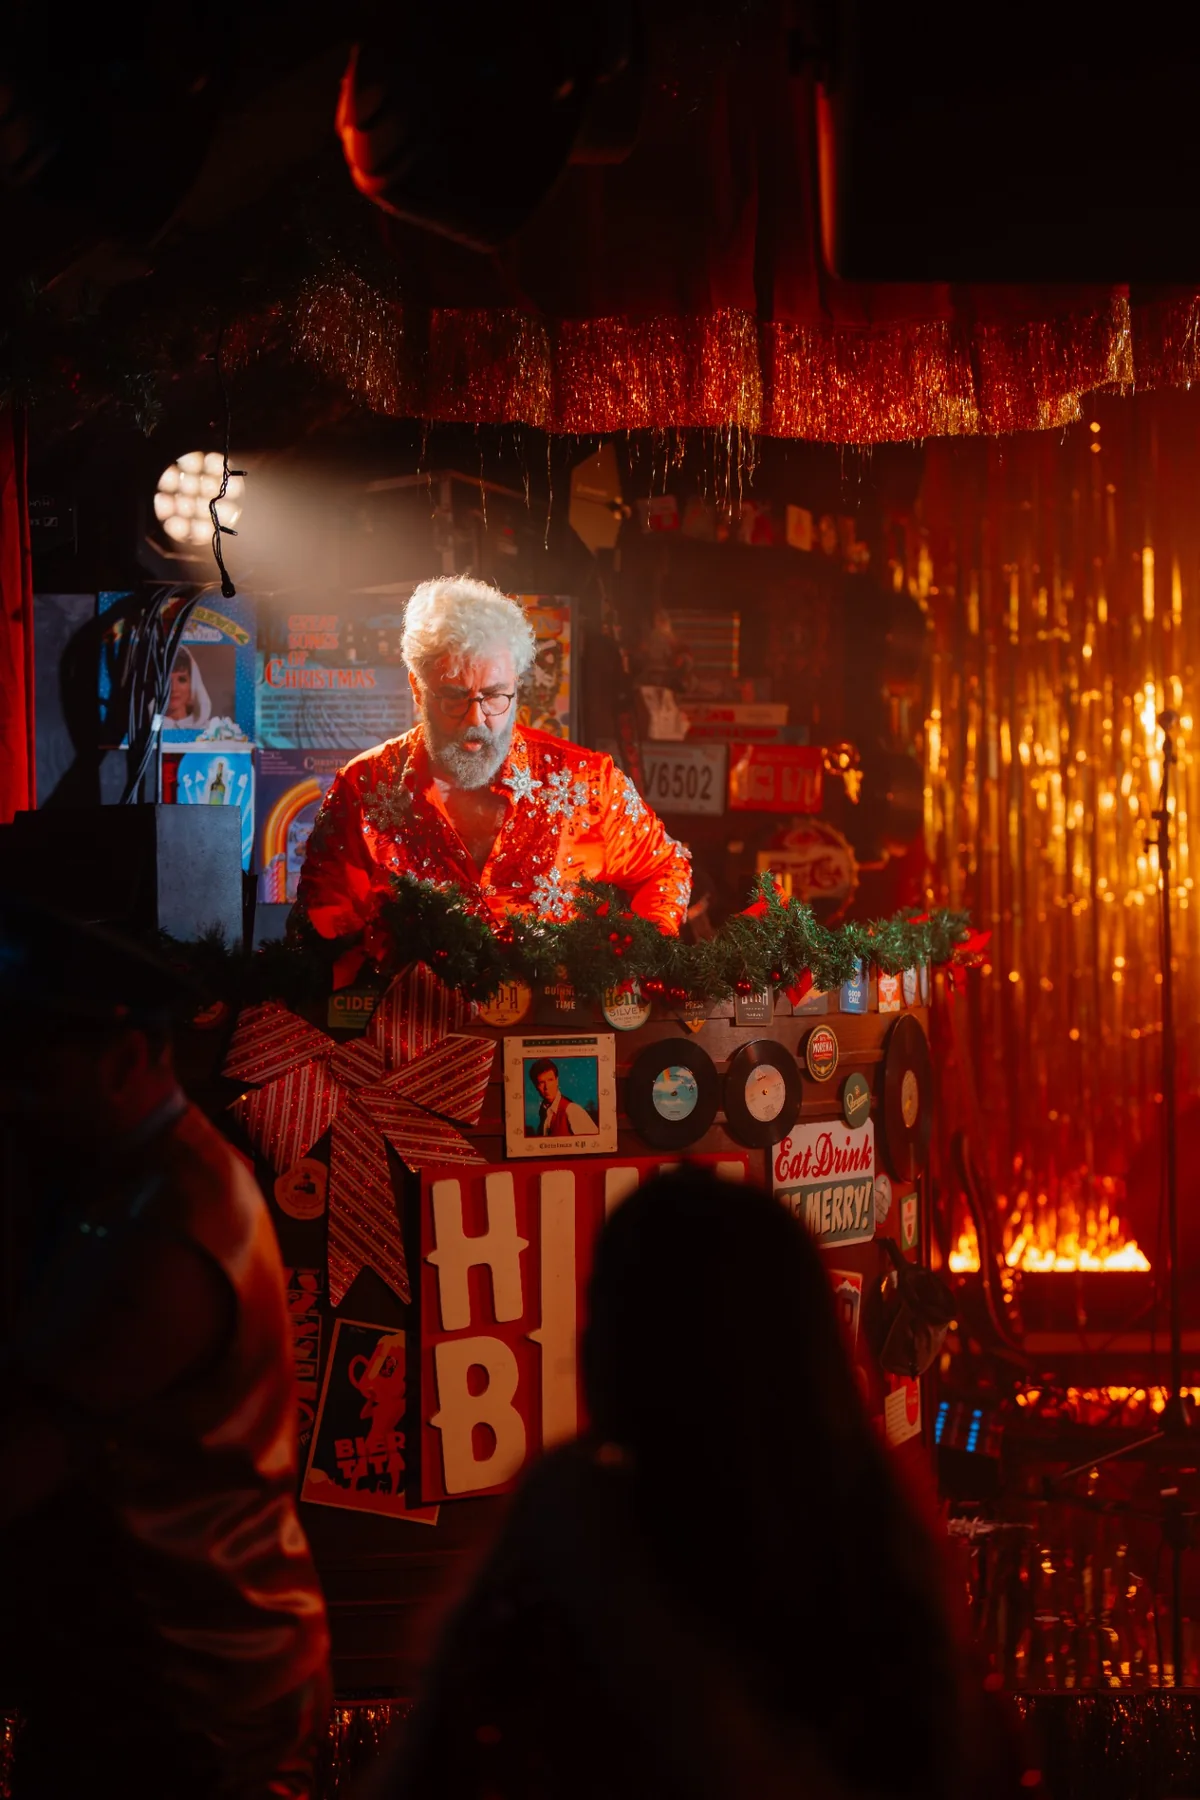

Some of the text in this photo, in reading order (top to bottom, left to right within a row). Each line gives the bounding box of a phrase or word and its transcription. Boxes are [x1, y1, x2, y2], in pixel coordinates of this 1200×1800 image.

[288, 651, 308, 666] OF
[333, 995, 375, 1011] CIDE
[555, 1001, 576, 1010] TIME
[609, 1007, 646, 1017] SILVER
[775, 1132, 872, 1182] Eat Drink
[805, 1181, 873, 1236] MERRY!
